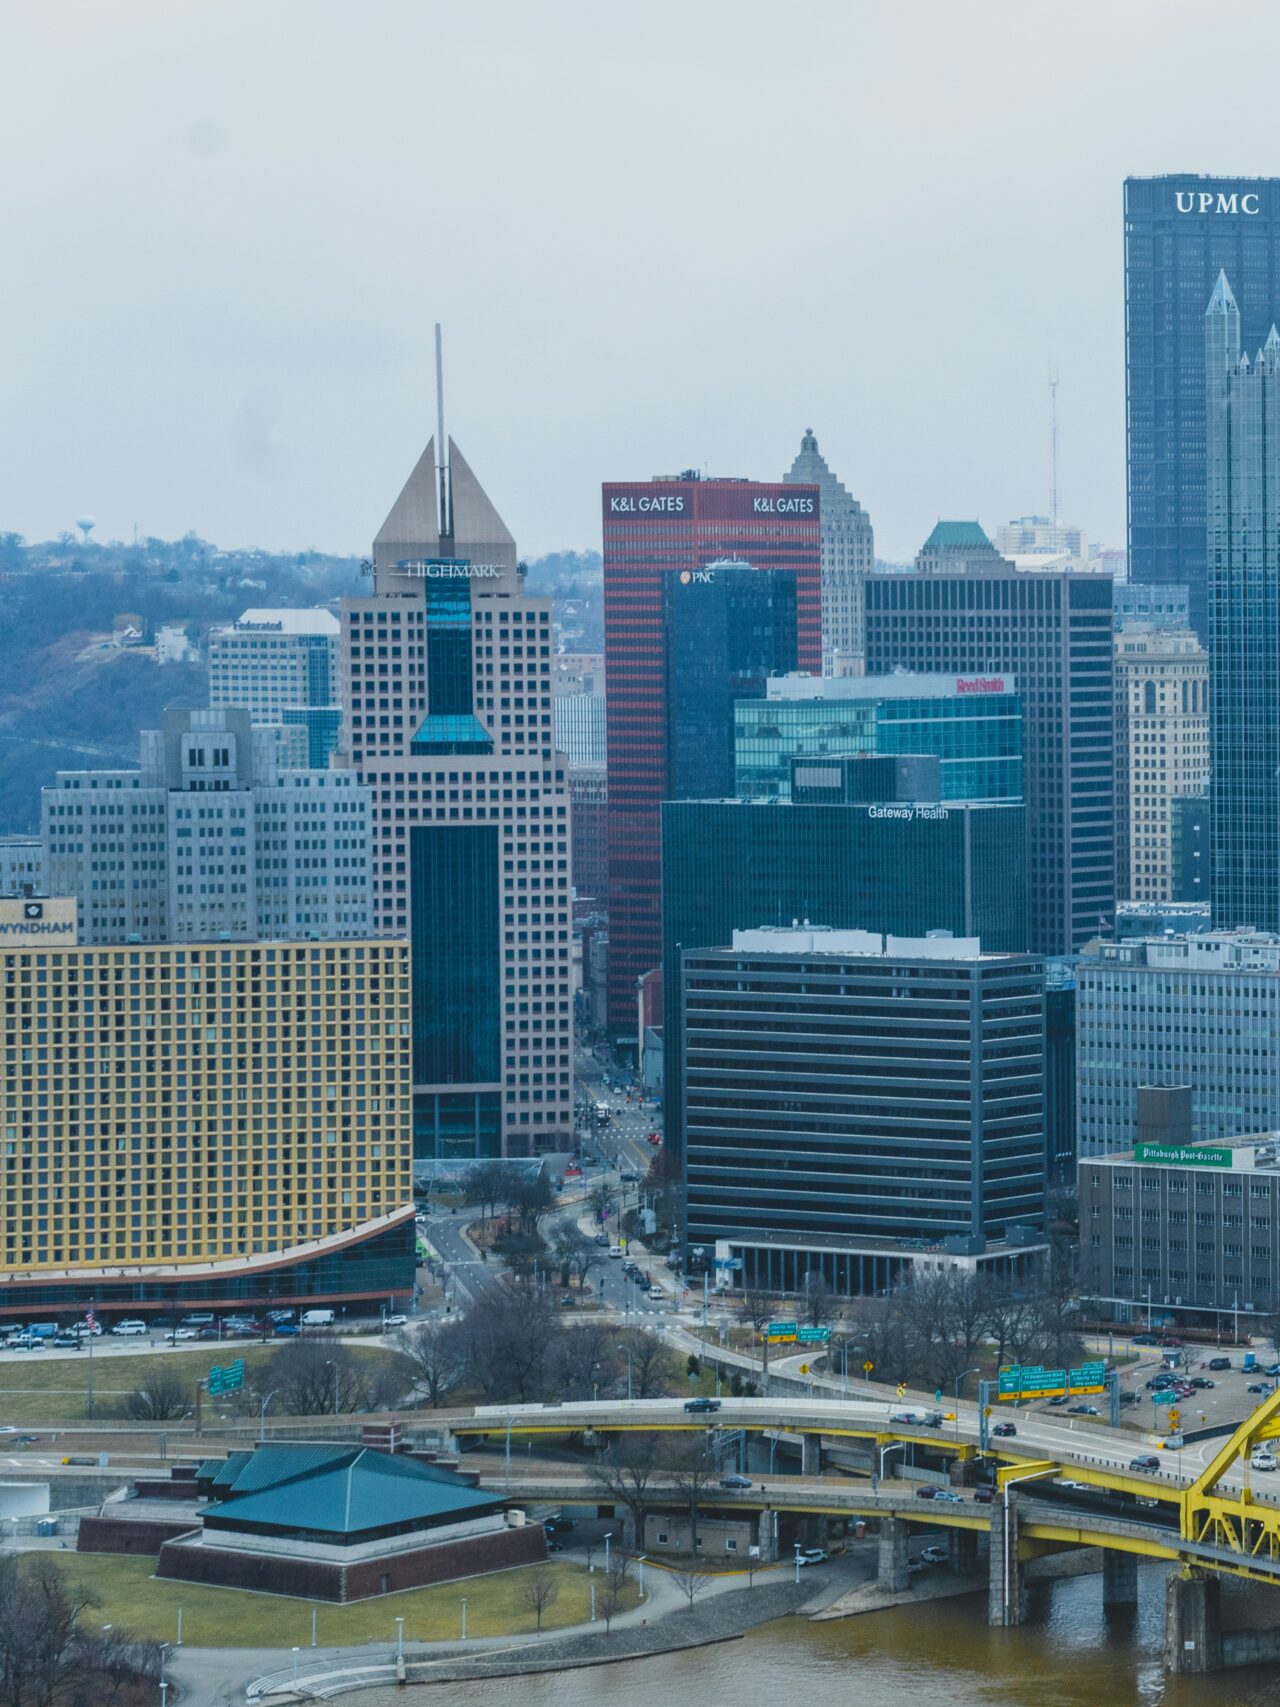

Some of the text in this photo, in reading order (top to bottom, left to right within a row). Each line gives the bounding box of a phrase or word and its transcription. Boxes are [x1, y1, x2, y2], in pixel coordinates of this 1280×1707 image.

[1174, 192, 1260, 214] UPMC
[611, 496, 684, 512] K&L GATES
[754, 498, 814, 513] K&L GATES
[407, 560, 500, 578] HIGHMARK
[692, 572, 715, 584] PNC
[232, 620, 282, 630] Federated
[957, 678, 1004, 692] Reed Smith
[868, 806, 948, 821] Gateway Health
[0, 922, 73, 934] WYNDHAM
[1144, 1148, 1222, 1161] Pittsburgh Post-Gazette
